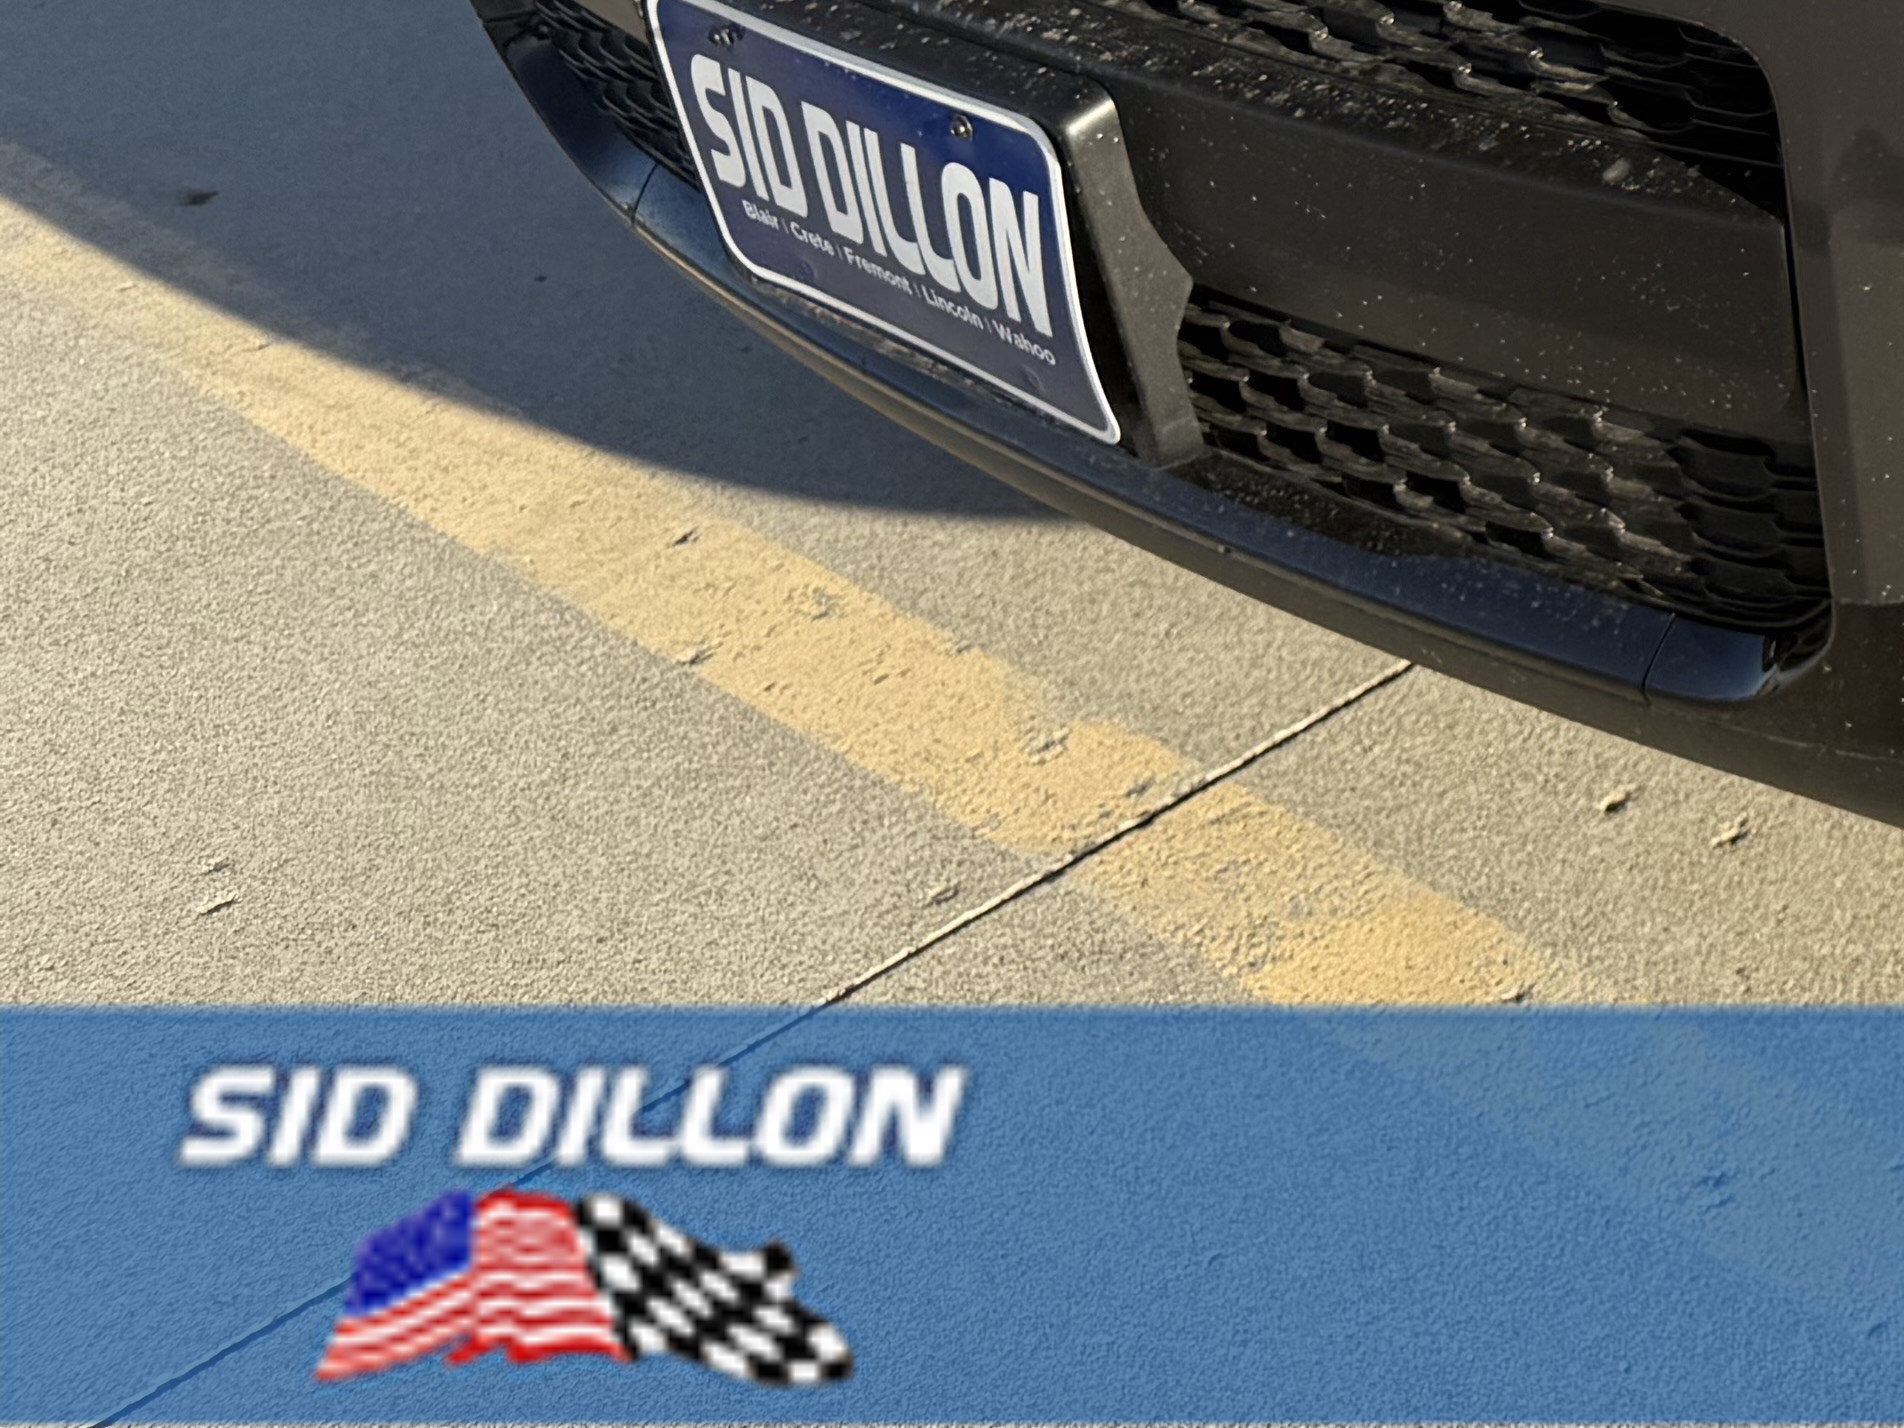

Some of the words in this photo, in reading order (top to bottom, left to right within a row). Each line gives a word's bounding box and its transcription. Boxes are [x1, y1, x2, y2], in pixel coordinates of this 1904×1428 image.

[690, 53, 809, 219] SID
[800, 100, 1053, 338] DILLON
[741, 199, 780, 233] Blair
[789, 221, 836, 257] Crete
[843, 246, 914, 296] Fremont
[921, 284, 985, 331] Lincoln
[992, 319, 1057, 367] Wahoo
